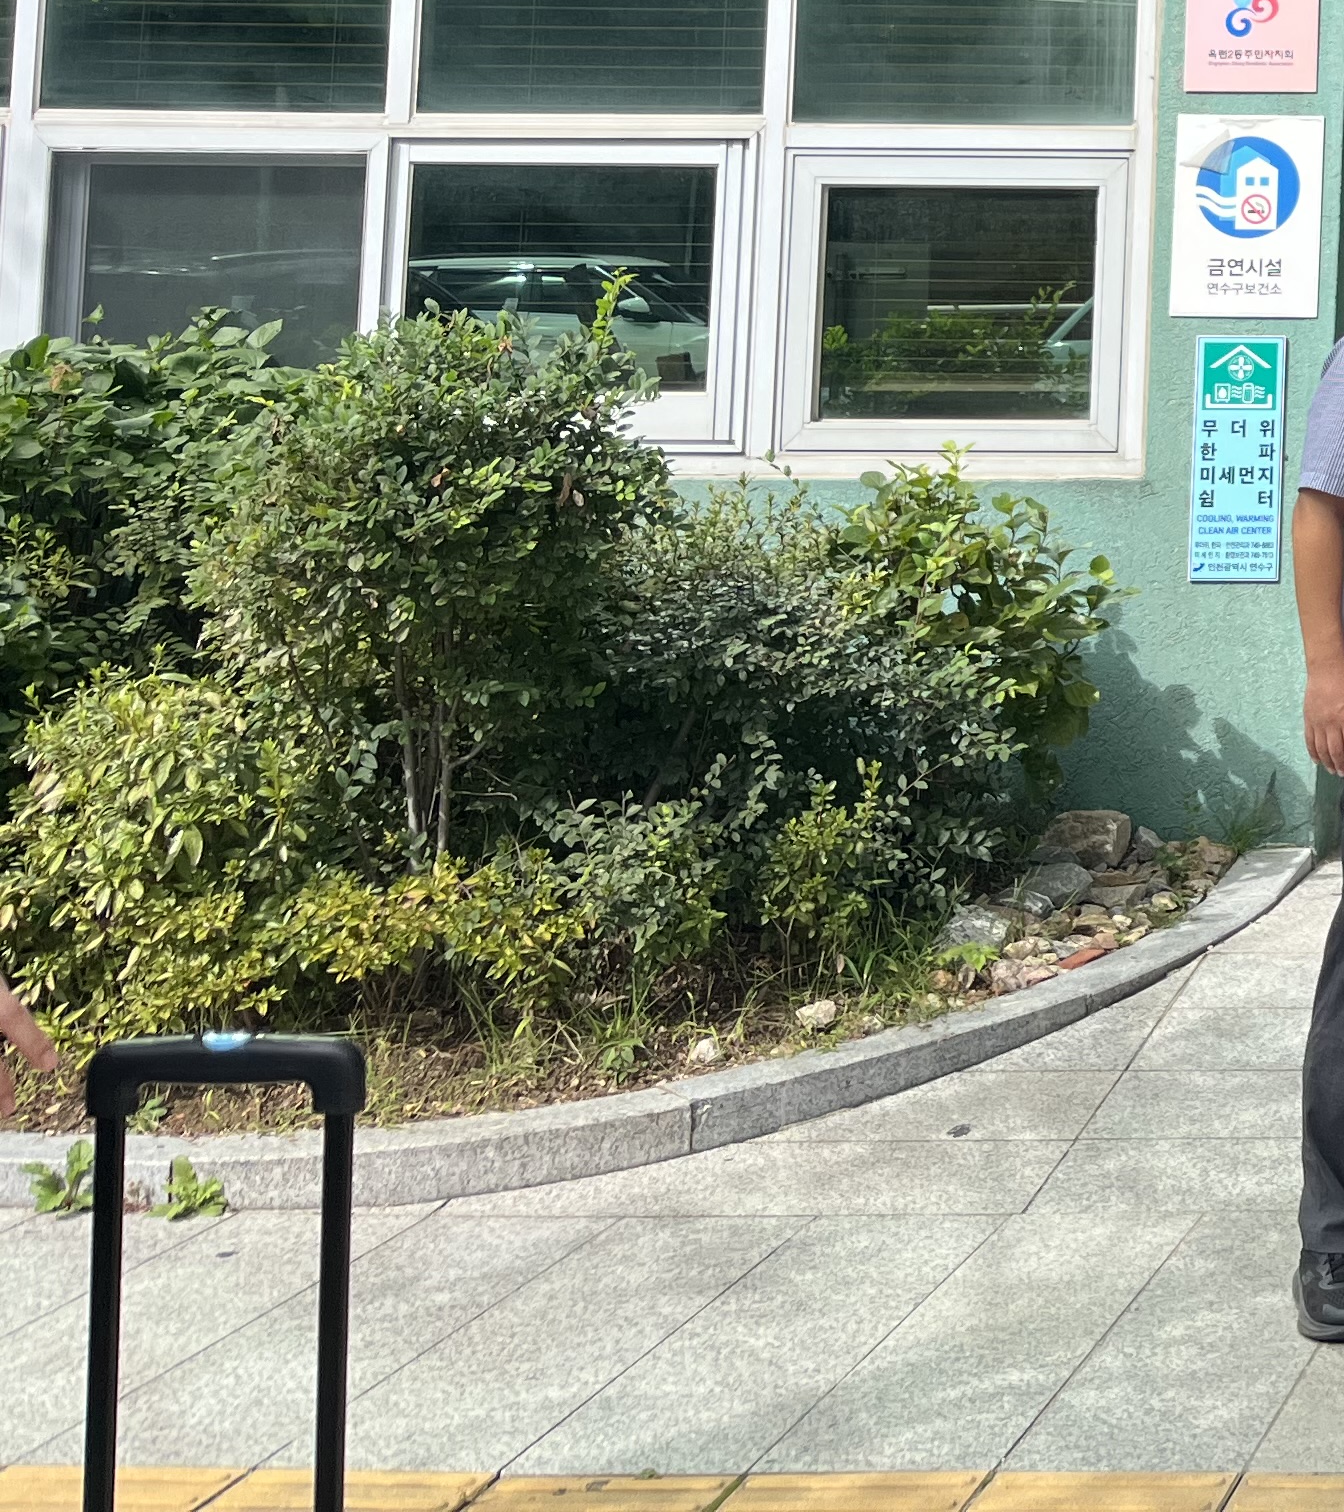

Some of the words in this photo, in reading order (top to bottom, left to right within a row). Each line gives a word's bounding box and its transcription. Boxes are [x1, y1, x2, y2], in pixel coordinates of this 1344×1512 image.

[1207, 258, 1282, 277] 금연시설
[1207, 282, 1282, 296] 연수구보건소
[1200, 466, 1274, 485] 미세먼지
[1196, 515, 1234, 523] COOLING,
[1236, 515, 1275, 523] WARMING
[1198, 526, 1224, 535] CLEAN
[1226, 526, 1239, 535] AIR
[1241, 526, 1272, 535] CENTER
